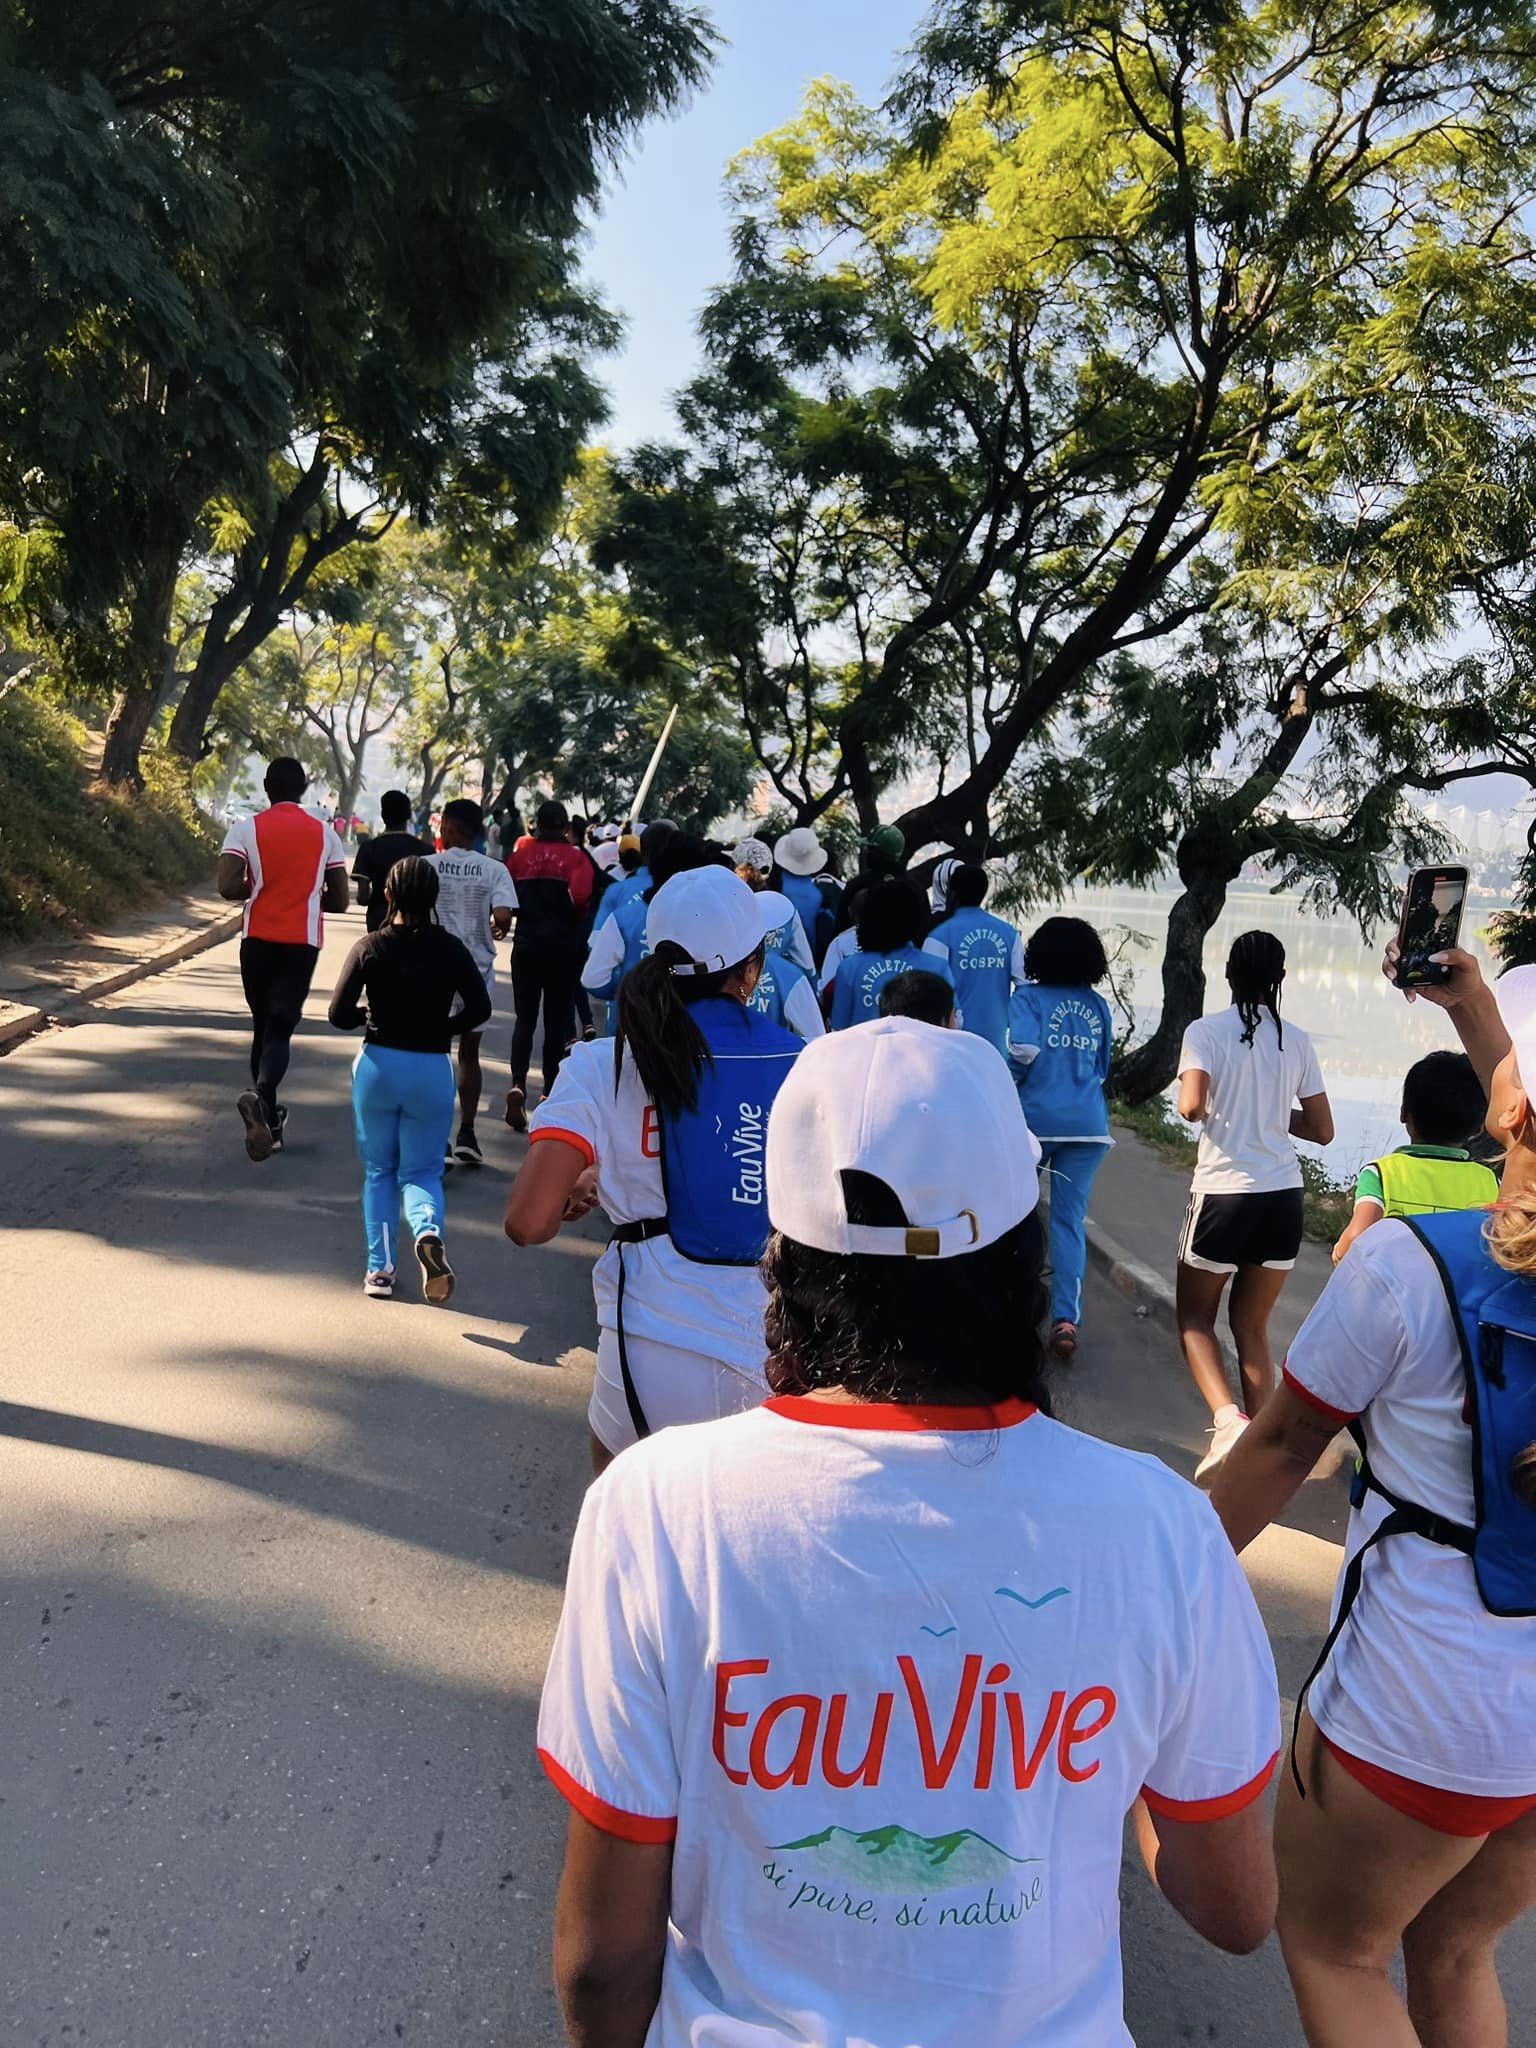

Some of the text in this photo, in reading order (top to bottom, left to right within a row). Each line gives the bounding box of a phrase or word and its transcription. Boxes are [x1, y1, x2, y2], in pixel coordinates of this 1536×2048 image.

[861, 959, 913, 992] ATHLETI
[959, 956, 1005, 970] COSPN
[1047, 1034, 1098, 1052] COSPN
[763, 1861, 793, 1890] si
[895, 1897, 928, 1926] si
[939, 1876, 1043, 1926] nature
